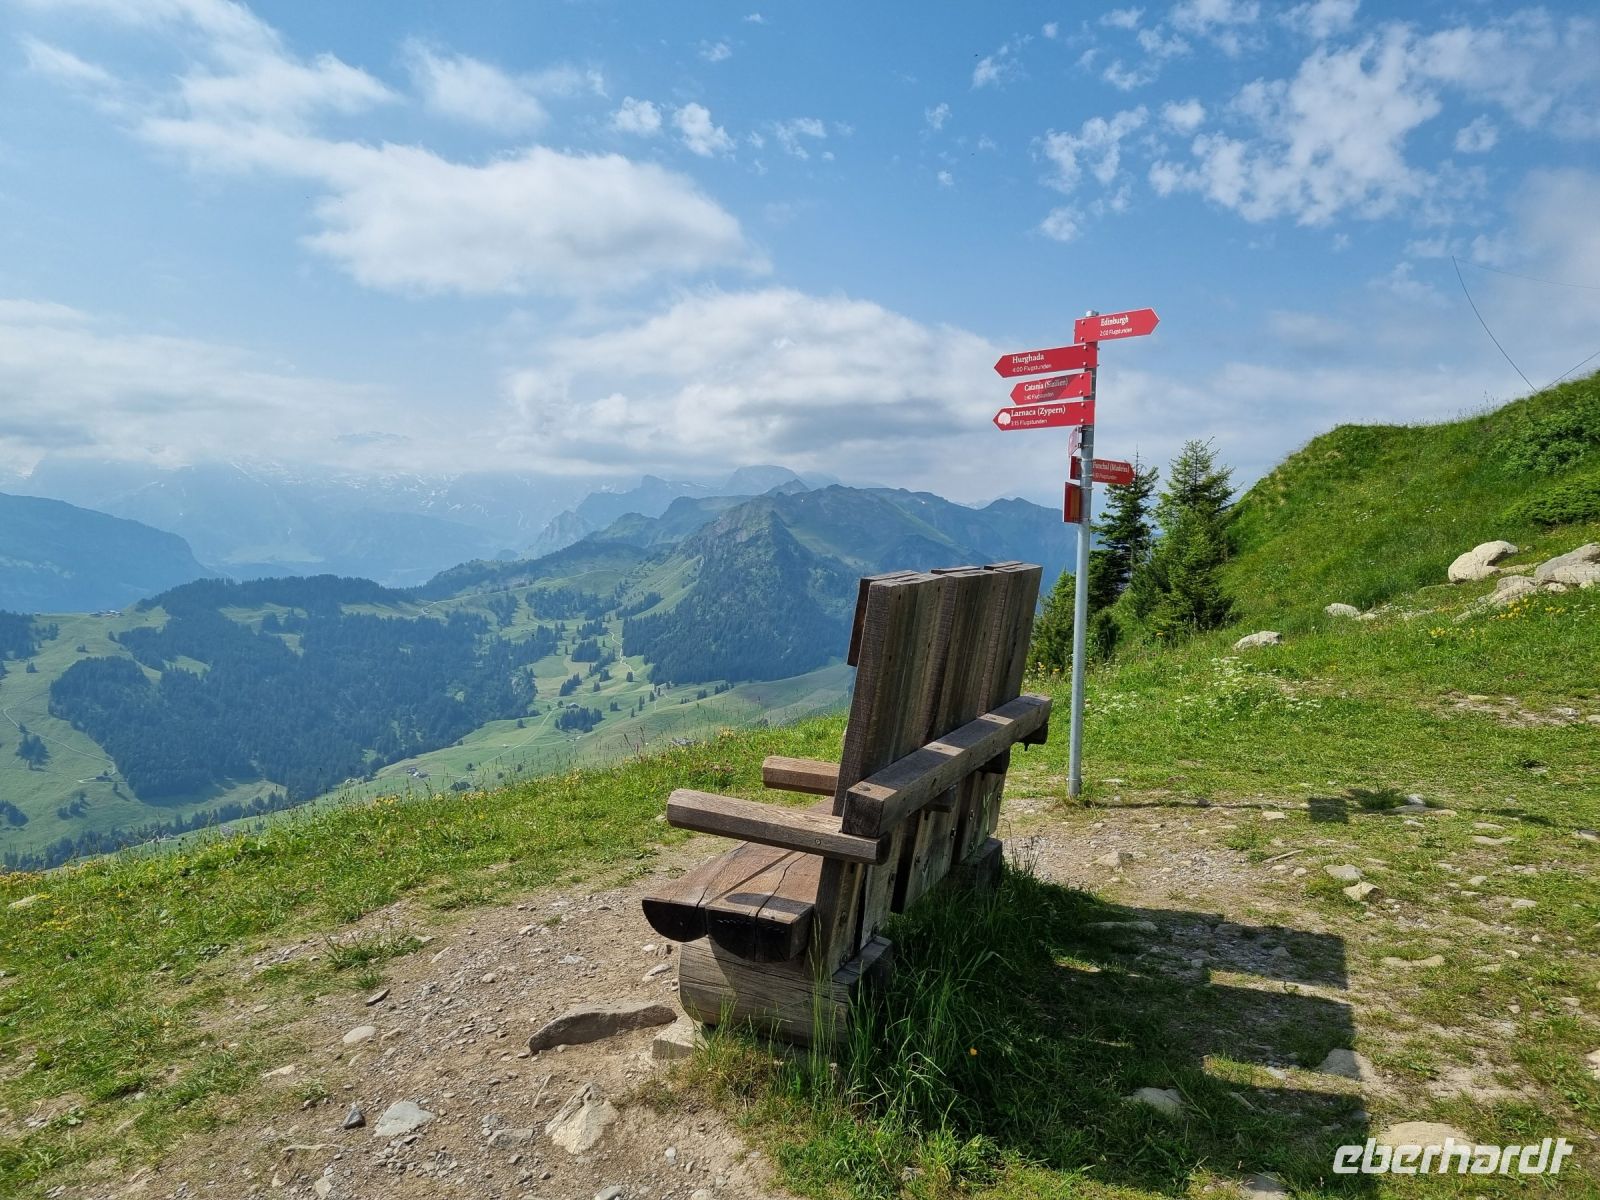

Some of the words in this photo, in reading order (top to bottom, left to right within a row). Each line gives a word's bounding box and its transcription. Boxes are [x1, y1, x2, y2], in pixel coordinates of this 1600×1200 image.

[1100, 315, 1129, 327] Edinburgh
[1012, 353, 1045, 364] Hurghada
[1024, 363, 1052, 372] Flugstunden
[1011, 409, 1036, 417] Larnaca
[1037, 405, 1066, 417] (Zypern)
[1020, 418, 1048, 426] Flugstunden
